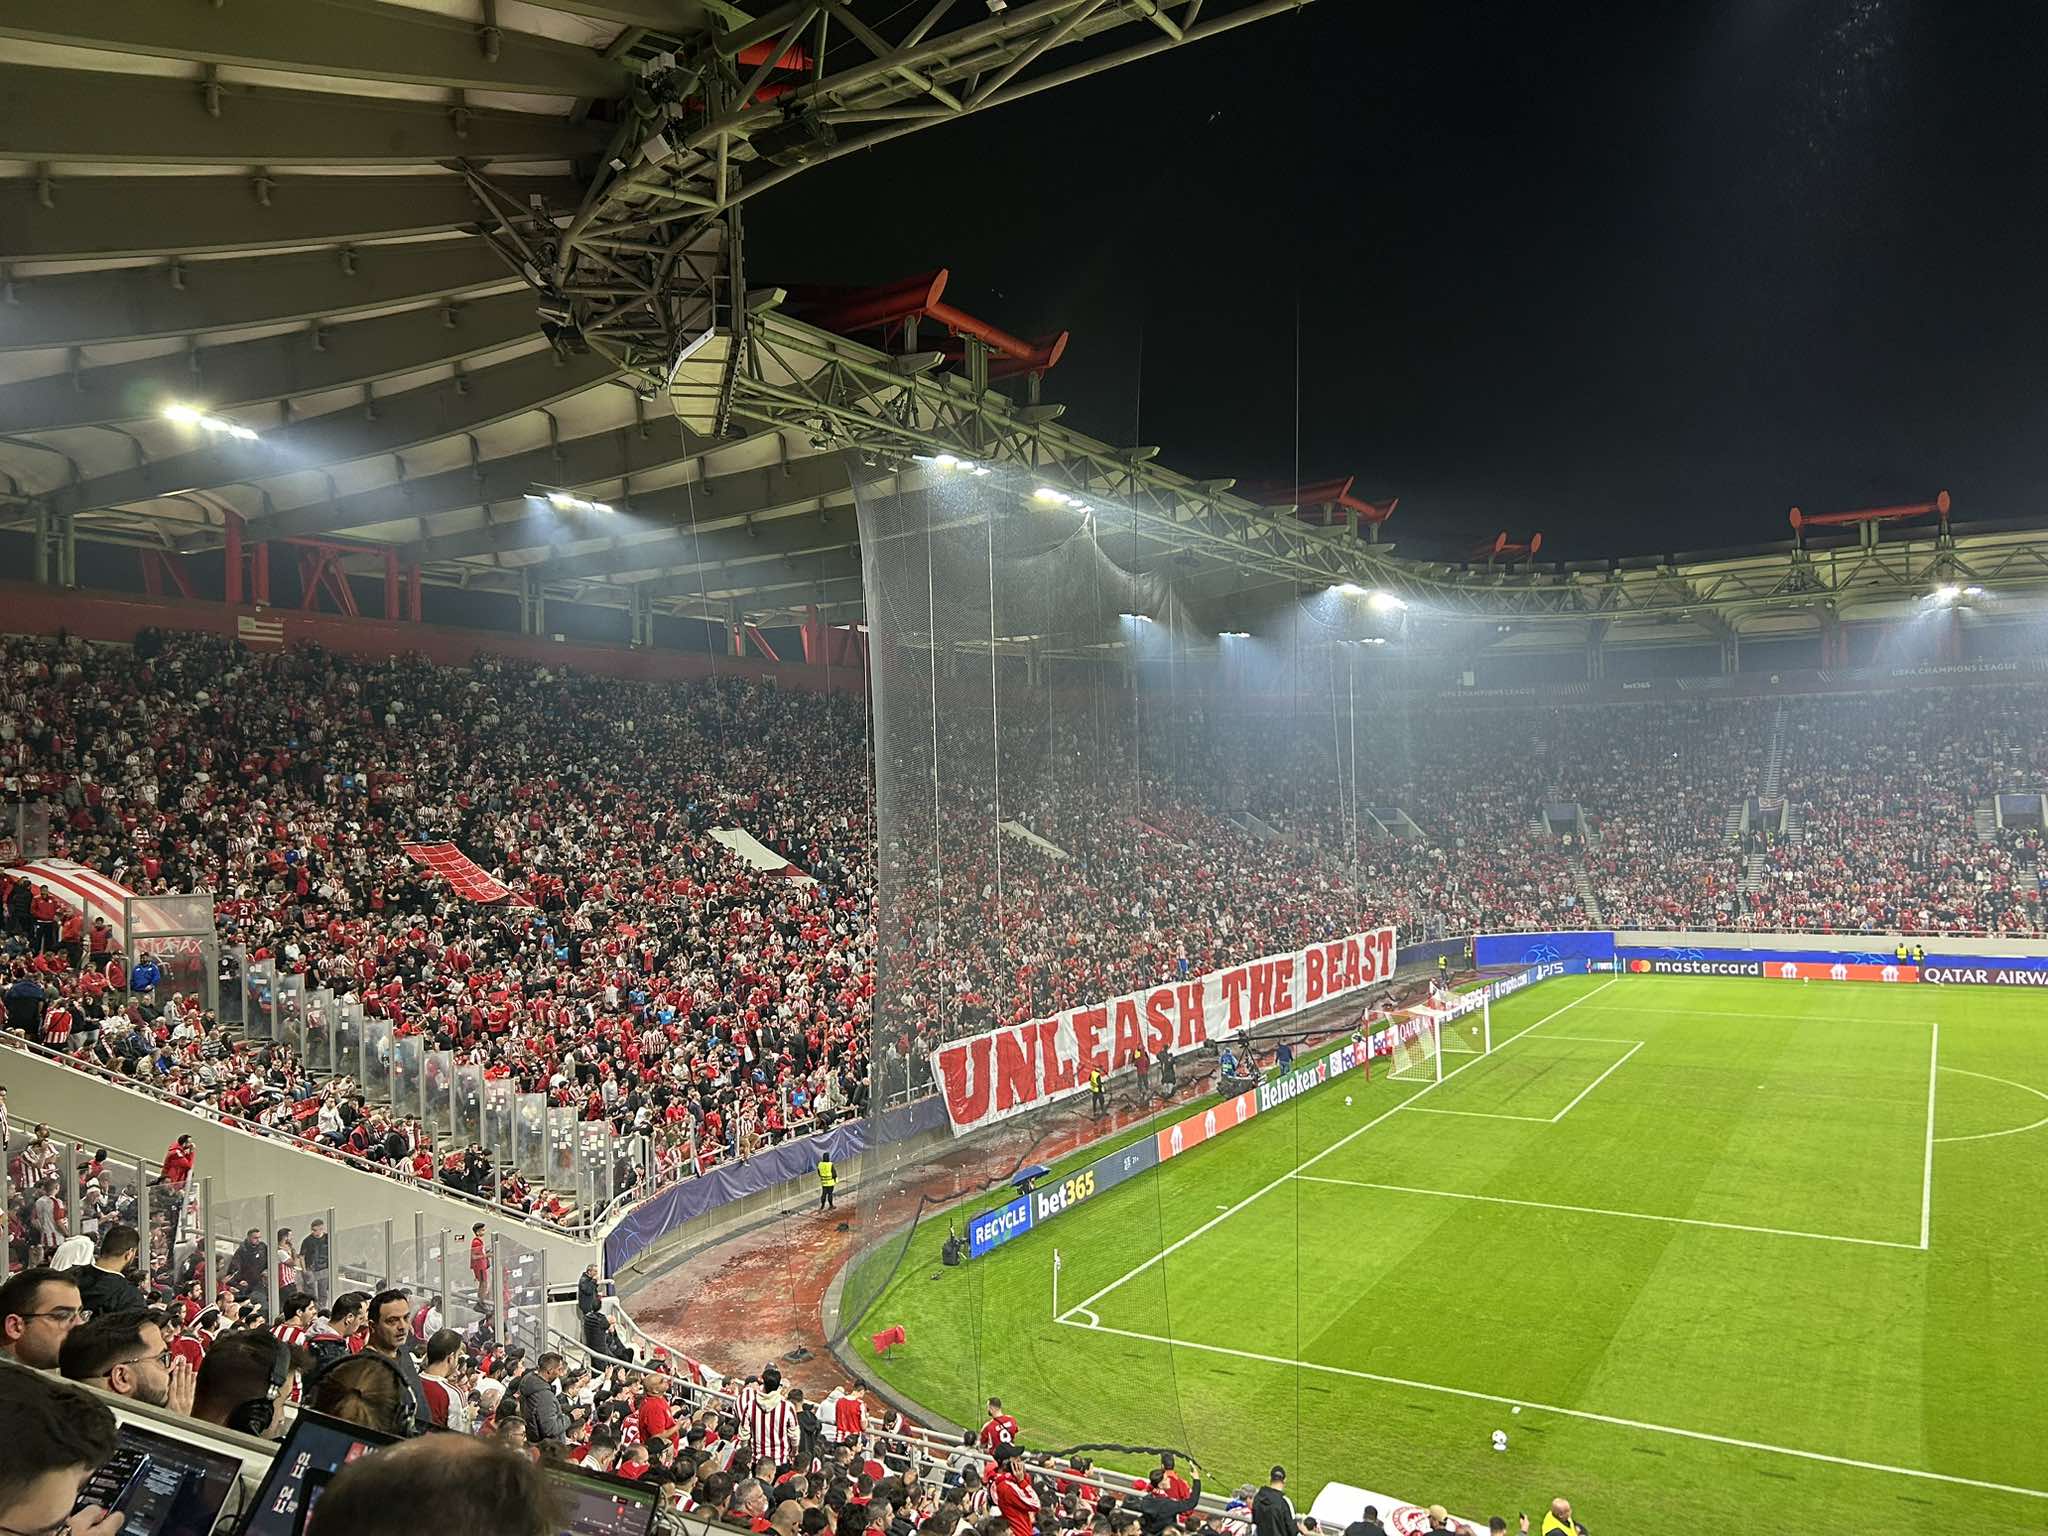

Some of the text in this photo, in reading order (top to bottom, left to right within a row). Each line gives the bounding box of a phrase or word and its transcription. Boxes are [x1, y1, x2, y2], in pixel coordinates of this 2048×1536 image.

[1918, 664, 1977, 675] CHAMPIONS
[1979, 661, 2018, 673] LEAGUE
[1655, 960, 1759, 975] mastercard
[1924, 967, 1988, 985] QATAR
[939, 930, 1393, 1125] UNLEASH THE BEAST
[1261, 1068, 1317, 1111] Heineken
[1037, 1170, 1095, 1220] bet365
[975, 1205, 1026, 1245] RECYCLE
